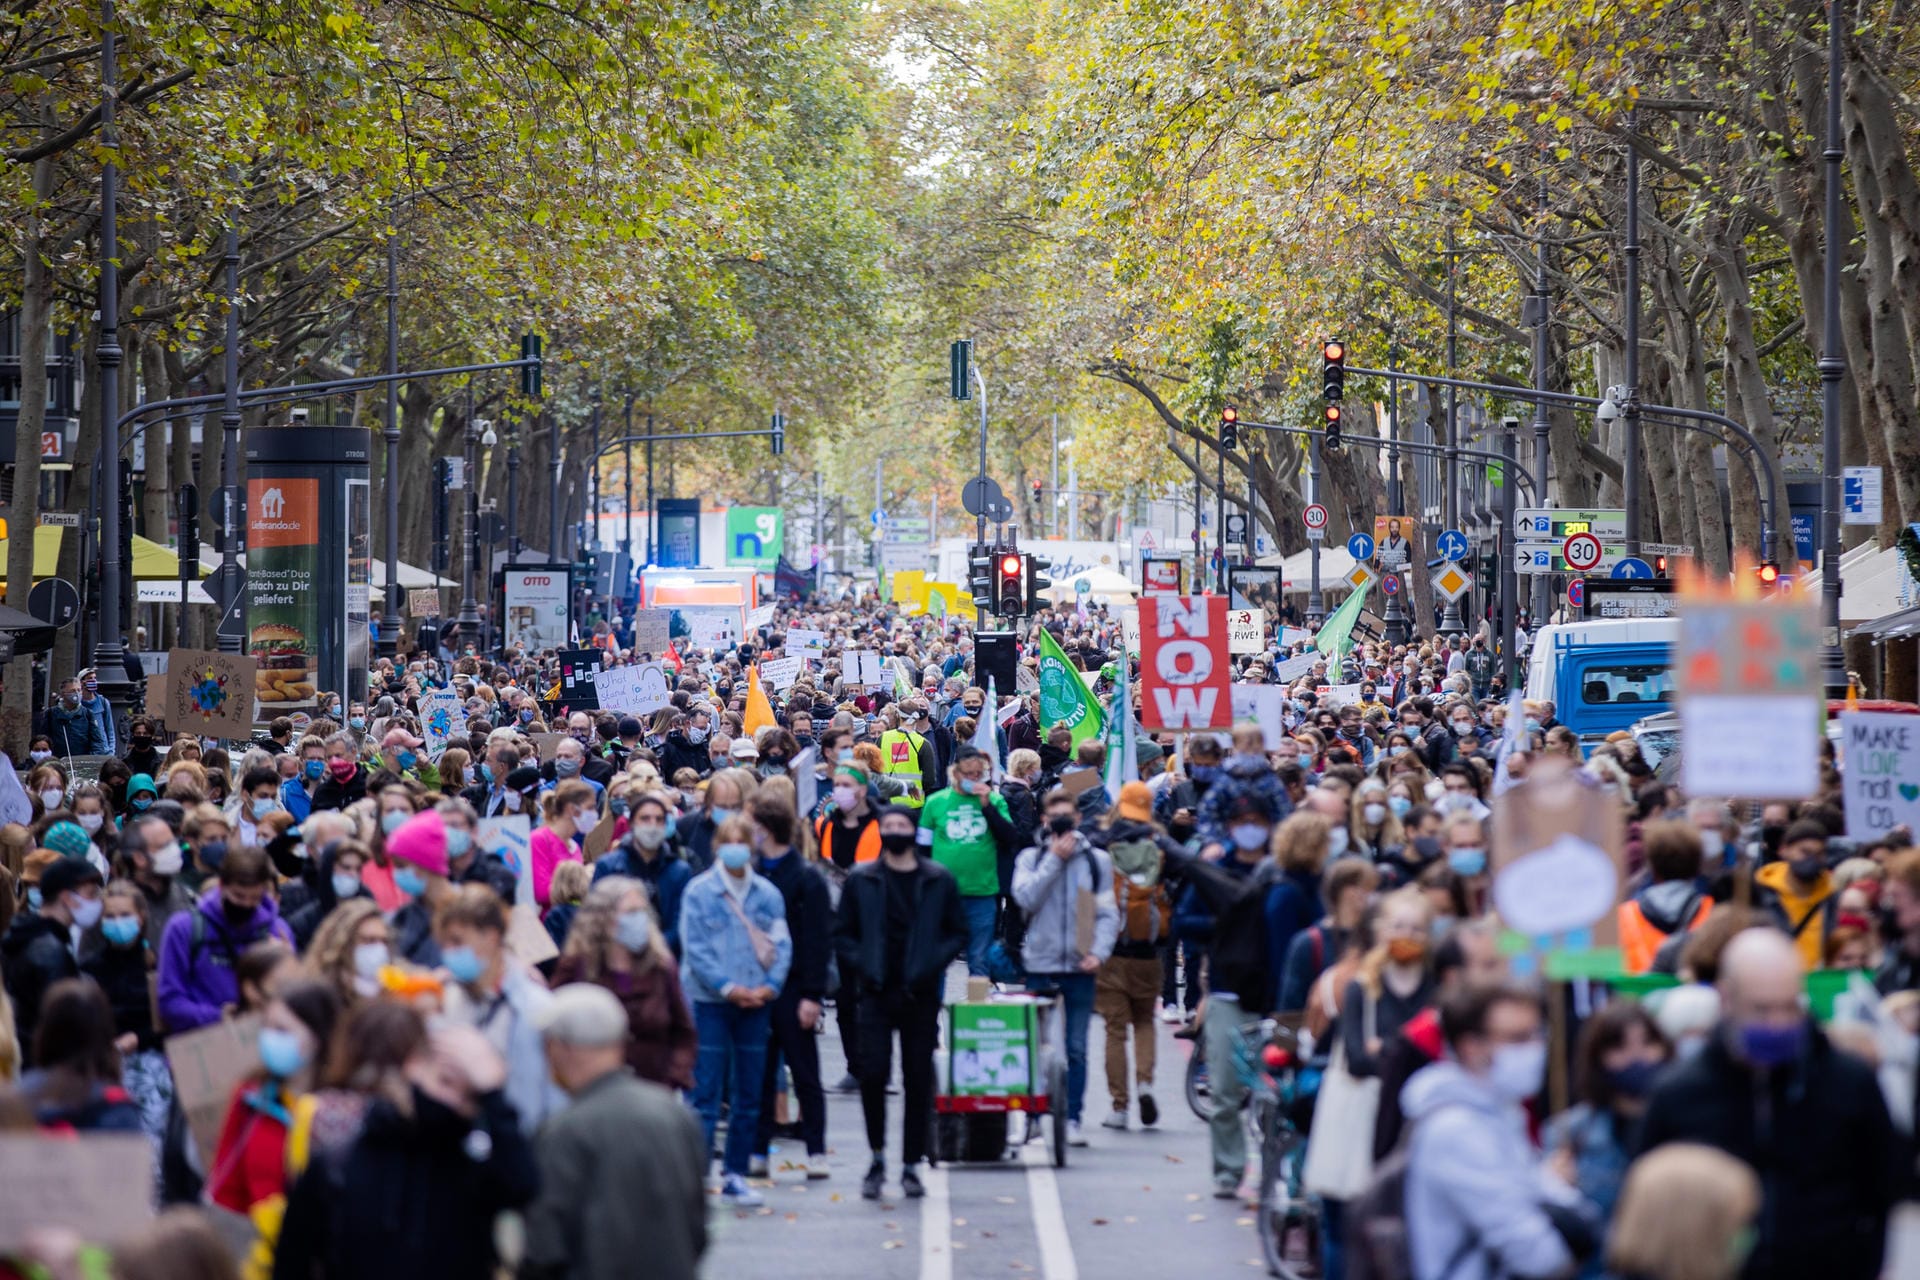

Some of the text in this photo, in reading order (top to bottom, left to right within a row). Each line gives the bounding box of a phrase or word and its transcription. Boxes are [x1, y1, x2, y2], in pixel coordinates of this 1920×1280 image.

[43, 514, 76, 525] Palmstr.
[1309, 511, 1323, 522] 30
[1579, 512, 1598, 520] Ringe
[1564, 522, 1589, 536] 200
[1571, 542, 1594, 560] 30
[1642, 543, 1692, 556] Limburger Str.
[291, 569, 311, 578] Duo
[292, 580, 310, 590] Dir
[523, 576, 551, 586] OTTO
[253, 593, 294, 606] geliefert
[1601, 599, 1617, 608] ICH
[1602, 607, 1631, 617] EURES
[1152, 597, 1219, 729] NOW
[1851, 724, 1911, 751] MAKE
[1858, 750, 1902, 776] LOVE
[1858, 778, 1891, 800] not
